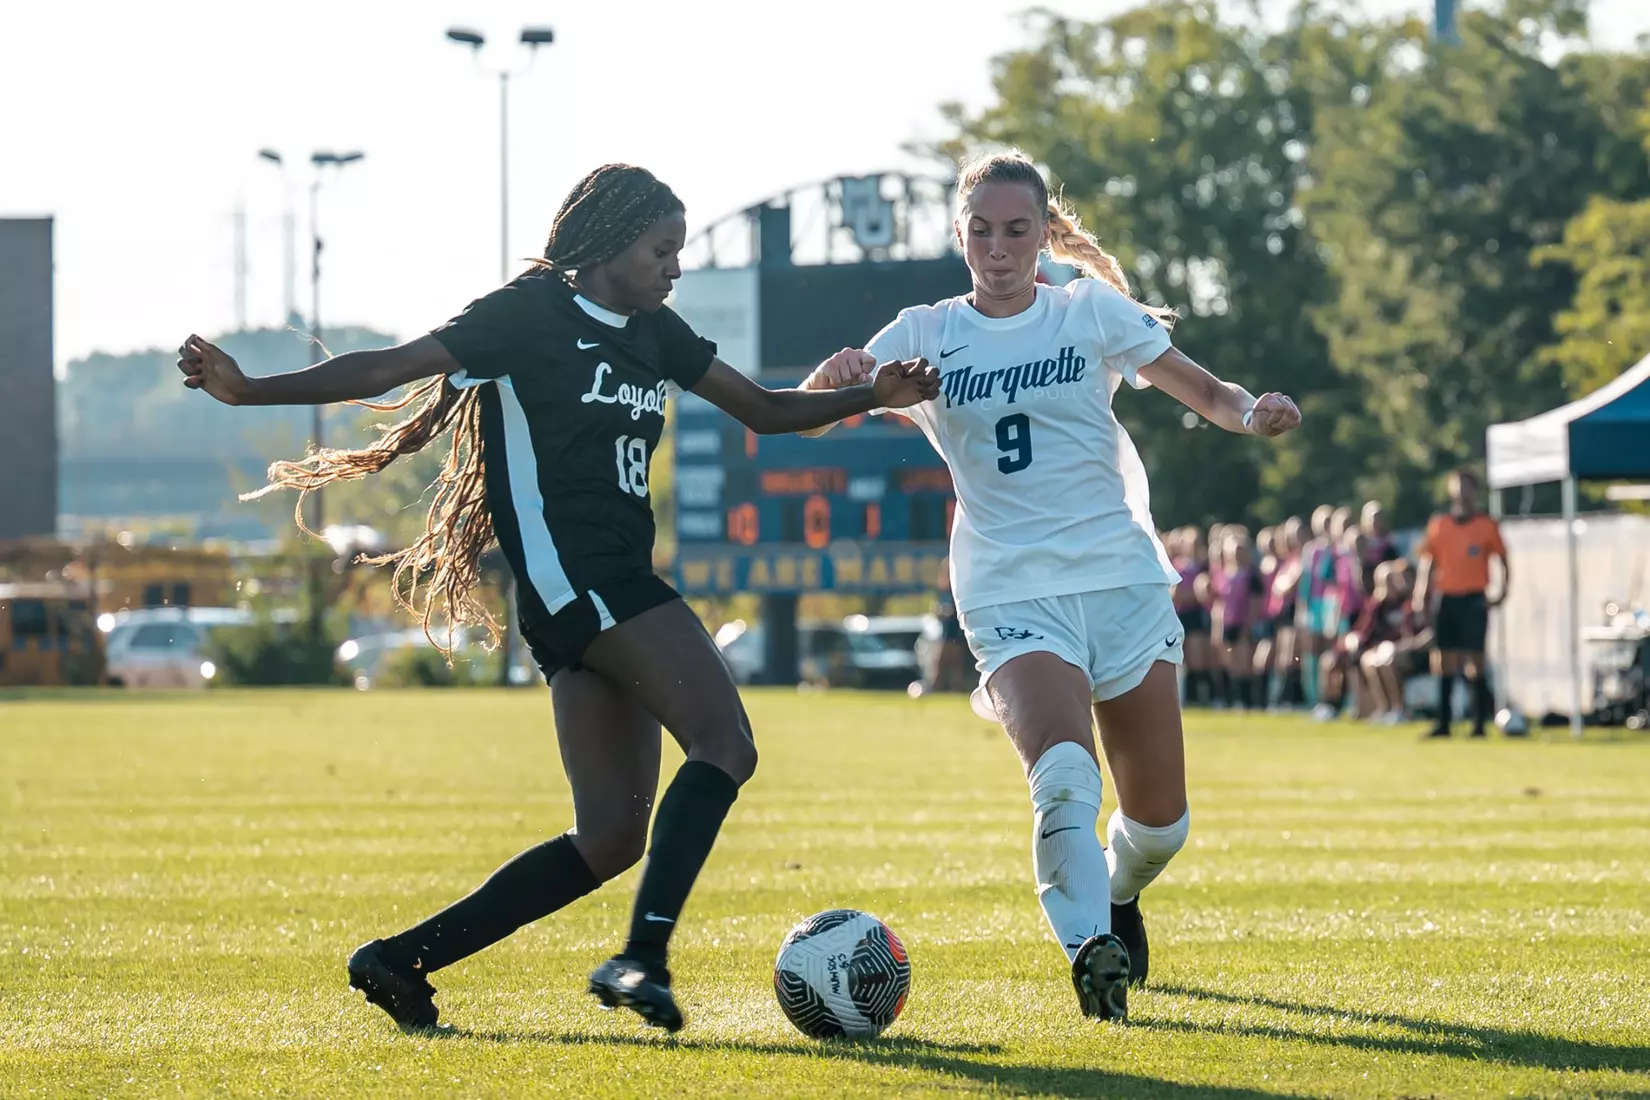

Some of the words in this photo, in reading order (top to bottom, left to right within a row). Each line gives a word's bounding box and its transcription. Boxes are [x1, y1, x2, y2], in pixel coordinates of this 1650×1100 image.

[940, 346, 1086, 408] Marquette
[980, 386, 1079, 411] CPULT
[615, 435, 648, 498] 18
[995, 412, 1033, 475] 9
[752, 555, 818, 586] ARE
